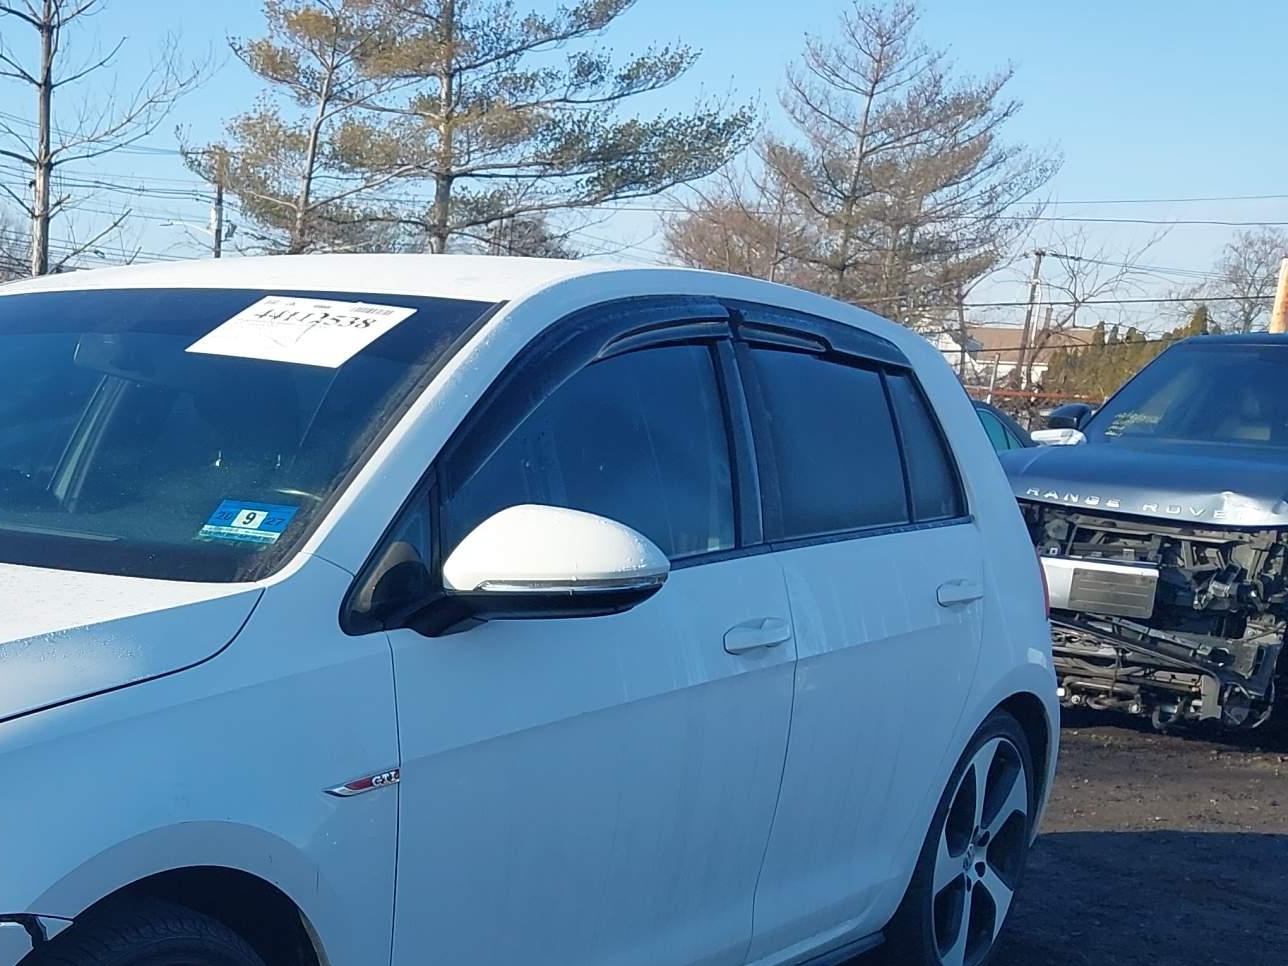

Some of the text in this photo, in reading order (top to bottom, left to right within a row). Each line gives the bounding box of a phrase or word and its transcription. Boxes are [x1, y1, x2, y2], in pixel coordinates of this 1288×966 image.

[1025, 487, 1249, 522] RANGE ROVE
[242, 511, 257, 525] 9
[371, 770, 399, 787] GTI
